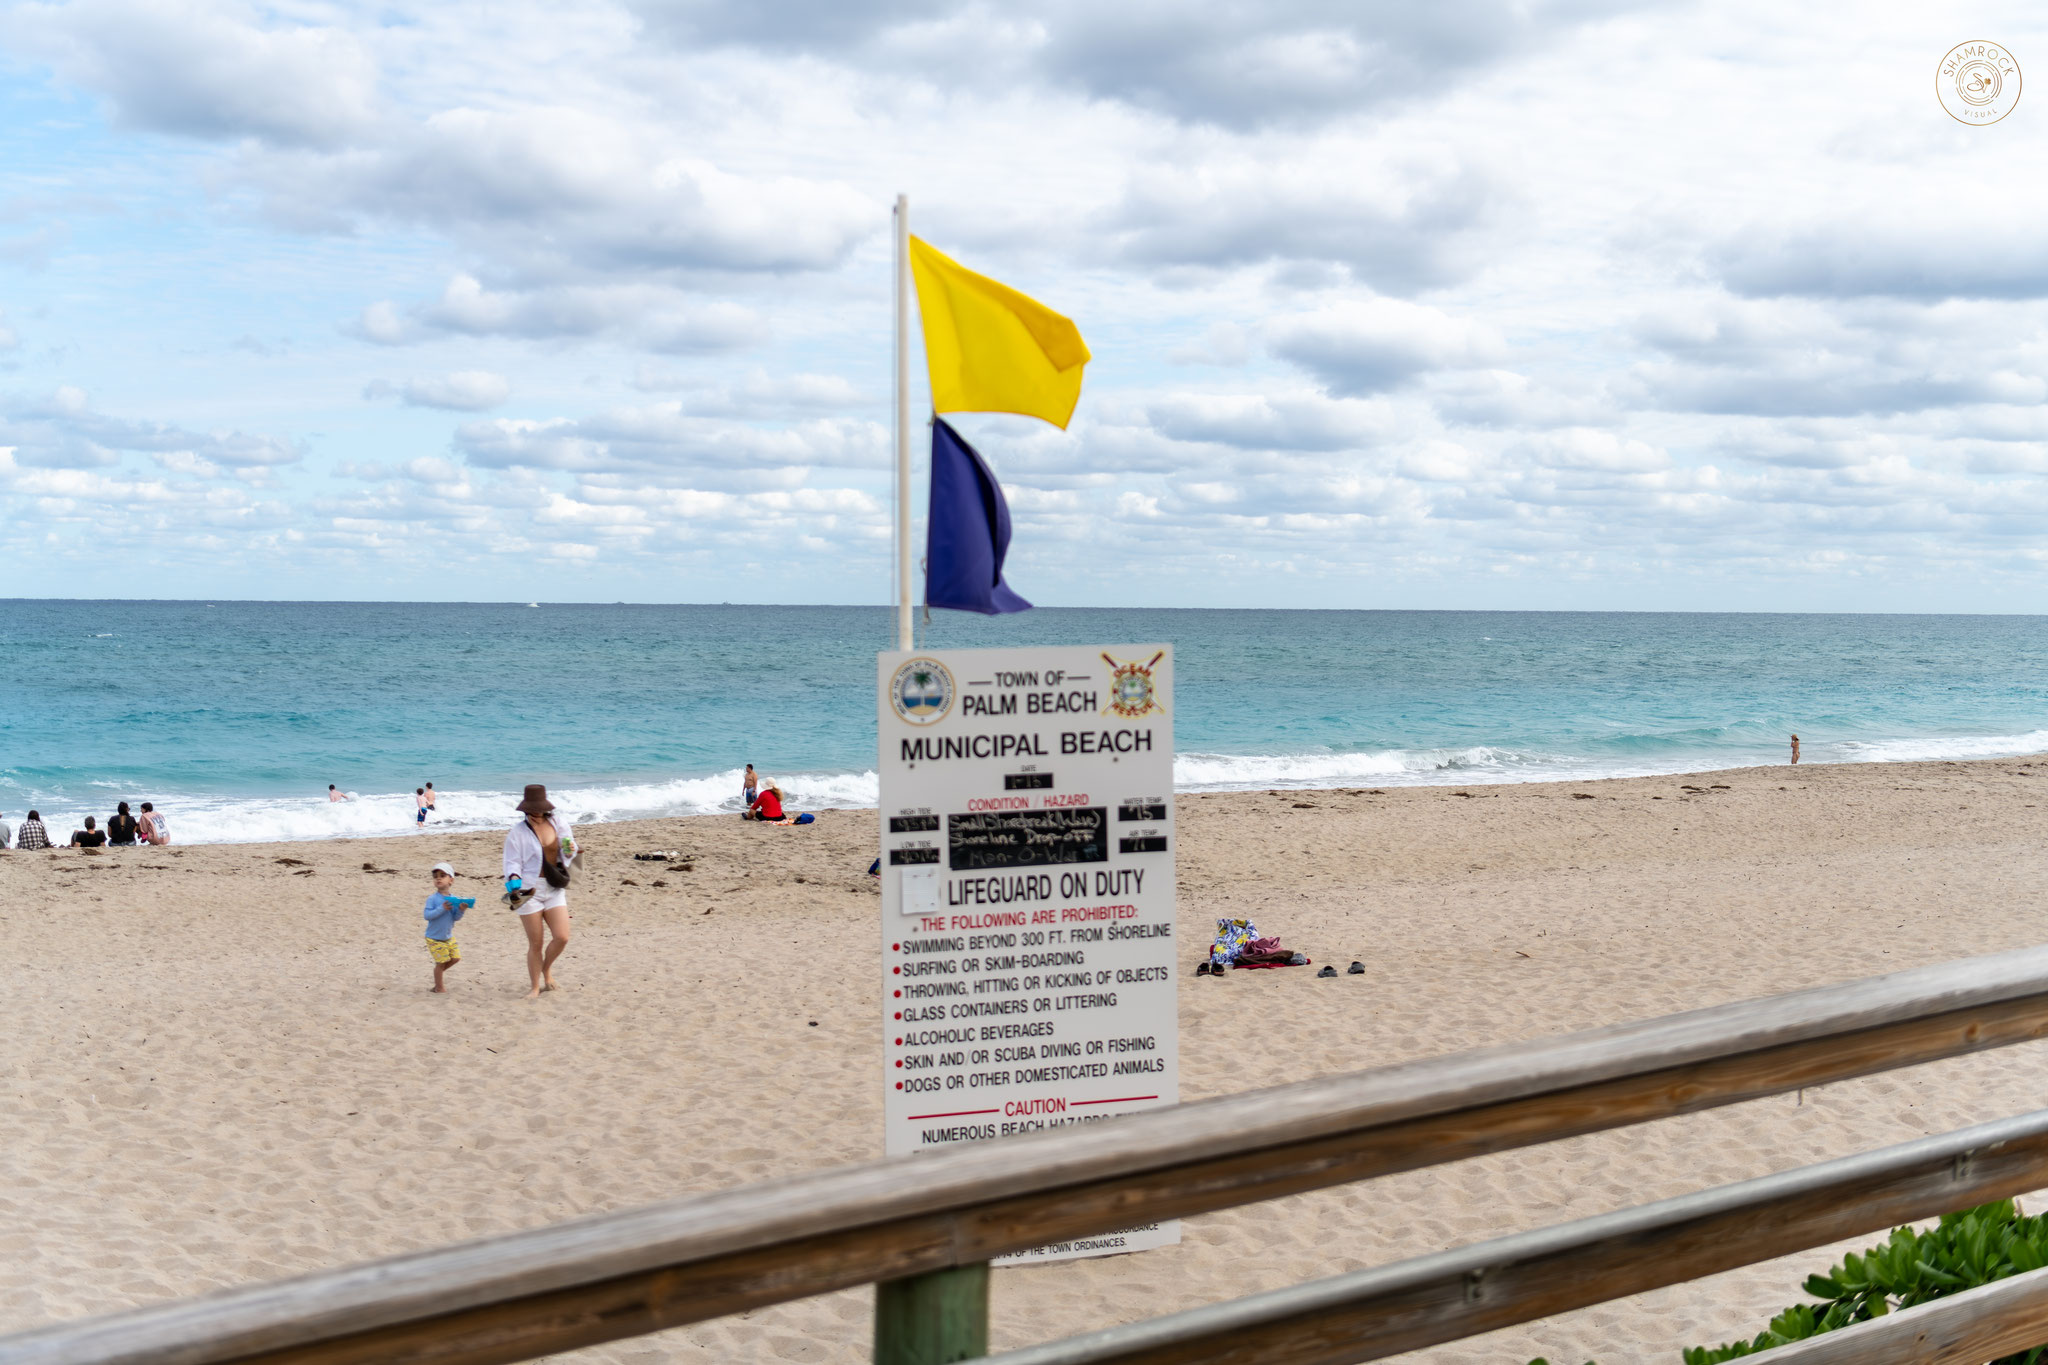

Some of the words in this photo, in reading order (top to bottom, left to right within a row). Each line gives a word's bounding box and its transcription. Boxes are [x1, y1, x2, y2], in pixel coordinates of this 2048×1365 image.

[994, 671, 1039, 688] TOWN
[1044, 670, 1065, 686] OF
[1113, 663, 1152, 680] OCEAN
[962, 693, 1017, 716] PALM
[1027, 690, 1097, 714] BEACH
[1111, 701, 1154, 717] RESCUE
[901, 732, 1049, 761] MUNICIPAL
[1060, 729, 1152, 755] BEACH
[968, 797, 1029, 812] CONDITION
[1043, 793, 1090, 808] HAZARD
[949, 874, 1052, 906] LIFEGUARD
[1060, 872, 1087, 899] ON
[1096, 868, 1144, 897] DUTY
[921, 917, 946, 932] THE
[951, 911, 1026, 930] FOLLOWING
[1031, 909, 1056, 924] ARE
[1061, 904, 1138, 922] PROHIBITED:
[903, 937, 965, 955] SWIMMING
[969, 933, 1017, 950] BEYOND
[1021, 931, 1044, 946] 300
[1049, 930, 1066, 944] FT.
[1070, 927, 1103, 942] FROM
[1108, 923, 1171, 941] SHORELINE
[903, 959, 957, 977] SURFING
[962, 958, 980, 972] OR
[985, 950, 1084, 971] SKIM-BOARDING
[903, 981, 969, 999] THROWING,
[974, 976, 1020, 994] HITTING
[1023, 975, 1041, 990] OR
[1045, 971, 1092, 988] KICKING
[1096, 970, 1112, 985] OF
[1116, 966, 1168, 983] OBJECTS
[903, 1005, 946, 1022] GLASS
[951, 999, 1029, 1019] CONTAINERS
[1033, 998, 1051, 1012] OR
[1056, 992, 1117, 1010] LITTERING
[904, 1027, 976, 1047] ALCOHOLIC
[981, 1021, 1054, 1041] BEVERAGES
[904, 1053, 934, 1070] SKIN
[939, 1049, 990, 1067] AND/OR
[994, 1045, 1036, 1063] SCUBA
[1041, 1042, 1081, 1059] DIVING
[1086, 1040, 1104, 1055] OR
[1108, 1036, 1155, 1053] FISHING
[904, 1076, 941, 1093] DOGS
[946, 1074, 964, 1089] OR
[969, 1070, 1010, 1087] OTHER
[1015, 1063, 1108, 1084] DOMESTICATED
[1112, 1058, 1165, 1076] ANIMALS
[1005, 1097, 1067, 1117] CAUTION
[922, 1123, 996, 1144] NUMEROUS
[1001, 1119, 1044, 1137] BEACH
[1030, 1244, 1045, 1256] THE
[1048, 1242, 1071, 1255] TOWN
[1073, 1236, 1128, 1252] ORDINANCES.
